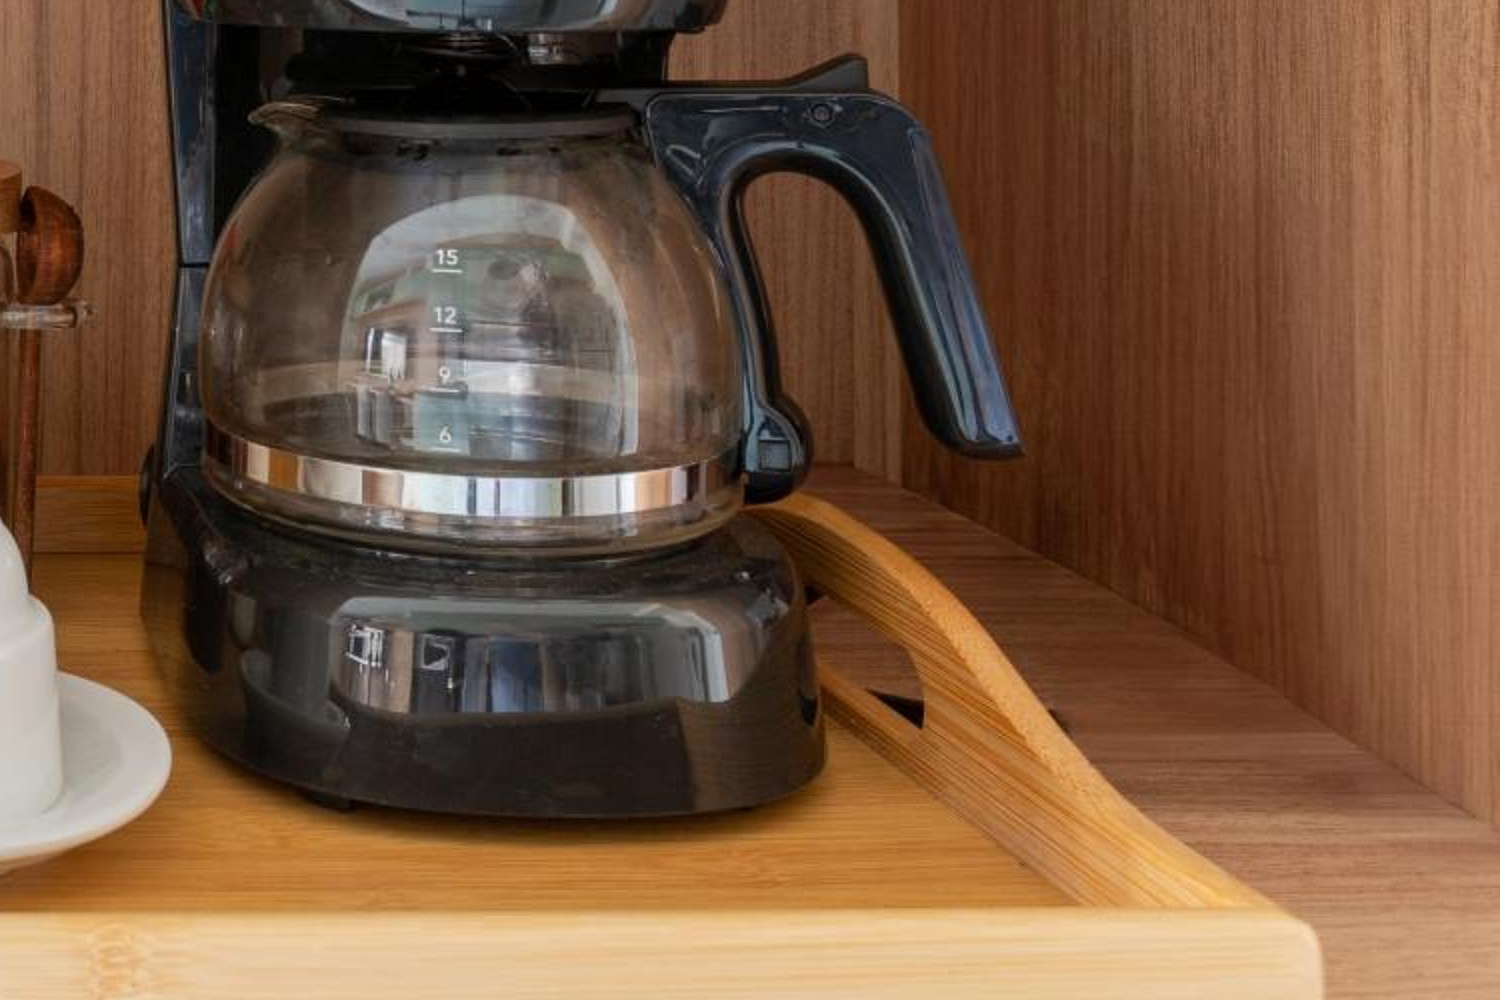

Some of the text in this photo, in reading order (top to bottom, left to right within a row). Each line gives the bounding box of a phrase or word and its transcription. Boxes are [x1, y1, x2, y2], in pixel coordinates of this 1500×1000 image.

[436, 248, 458, 265] 15
[435, 306, 457, 324] 12
[439, 366, 451, 384] 9
[439, 426, 451, 444] 6
